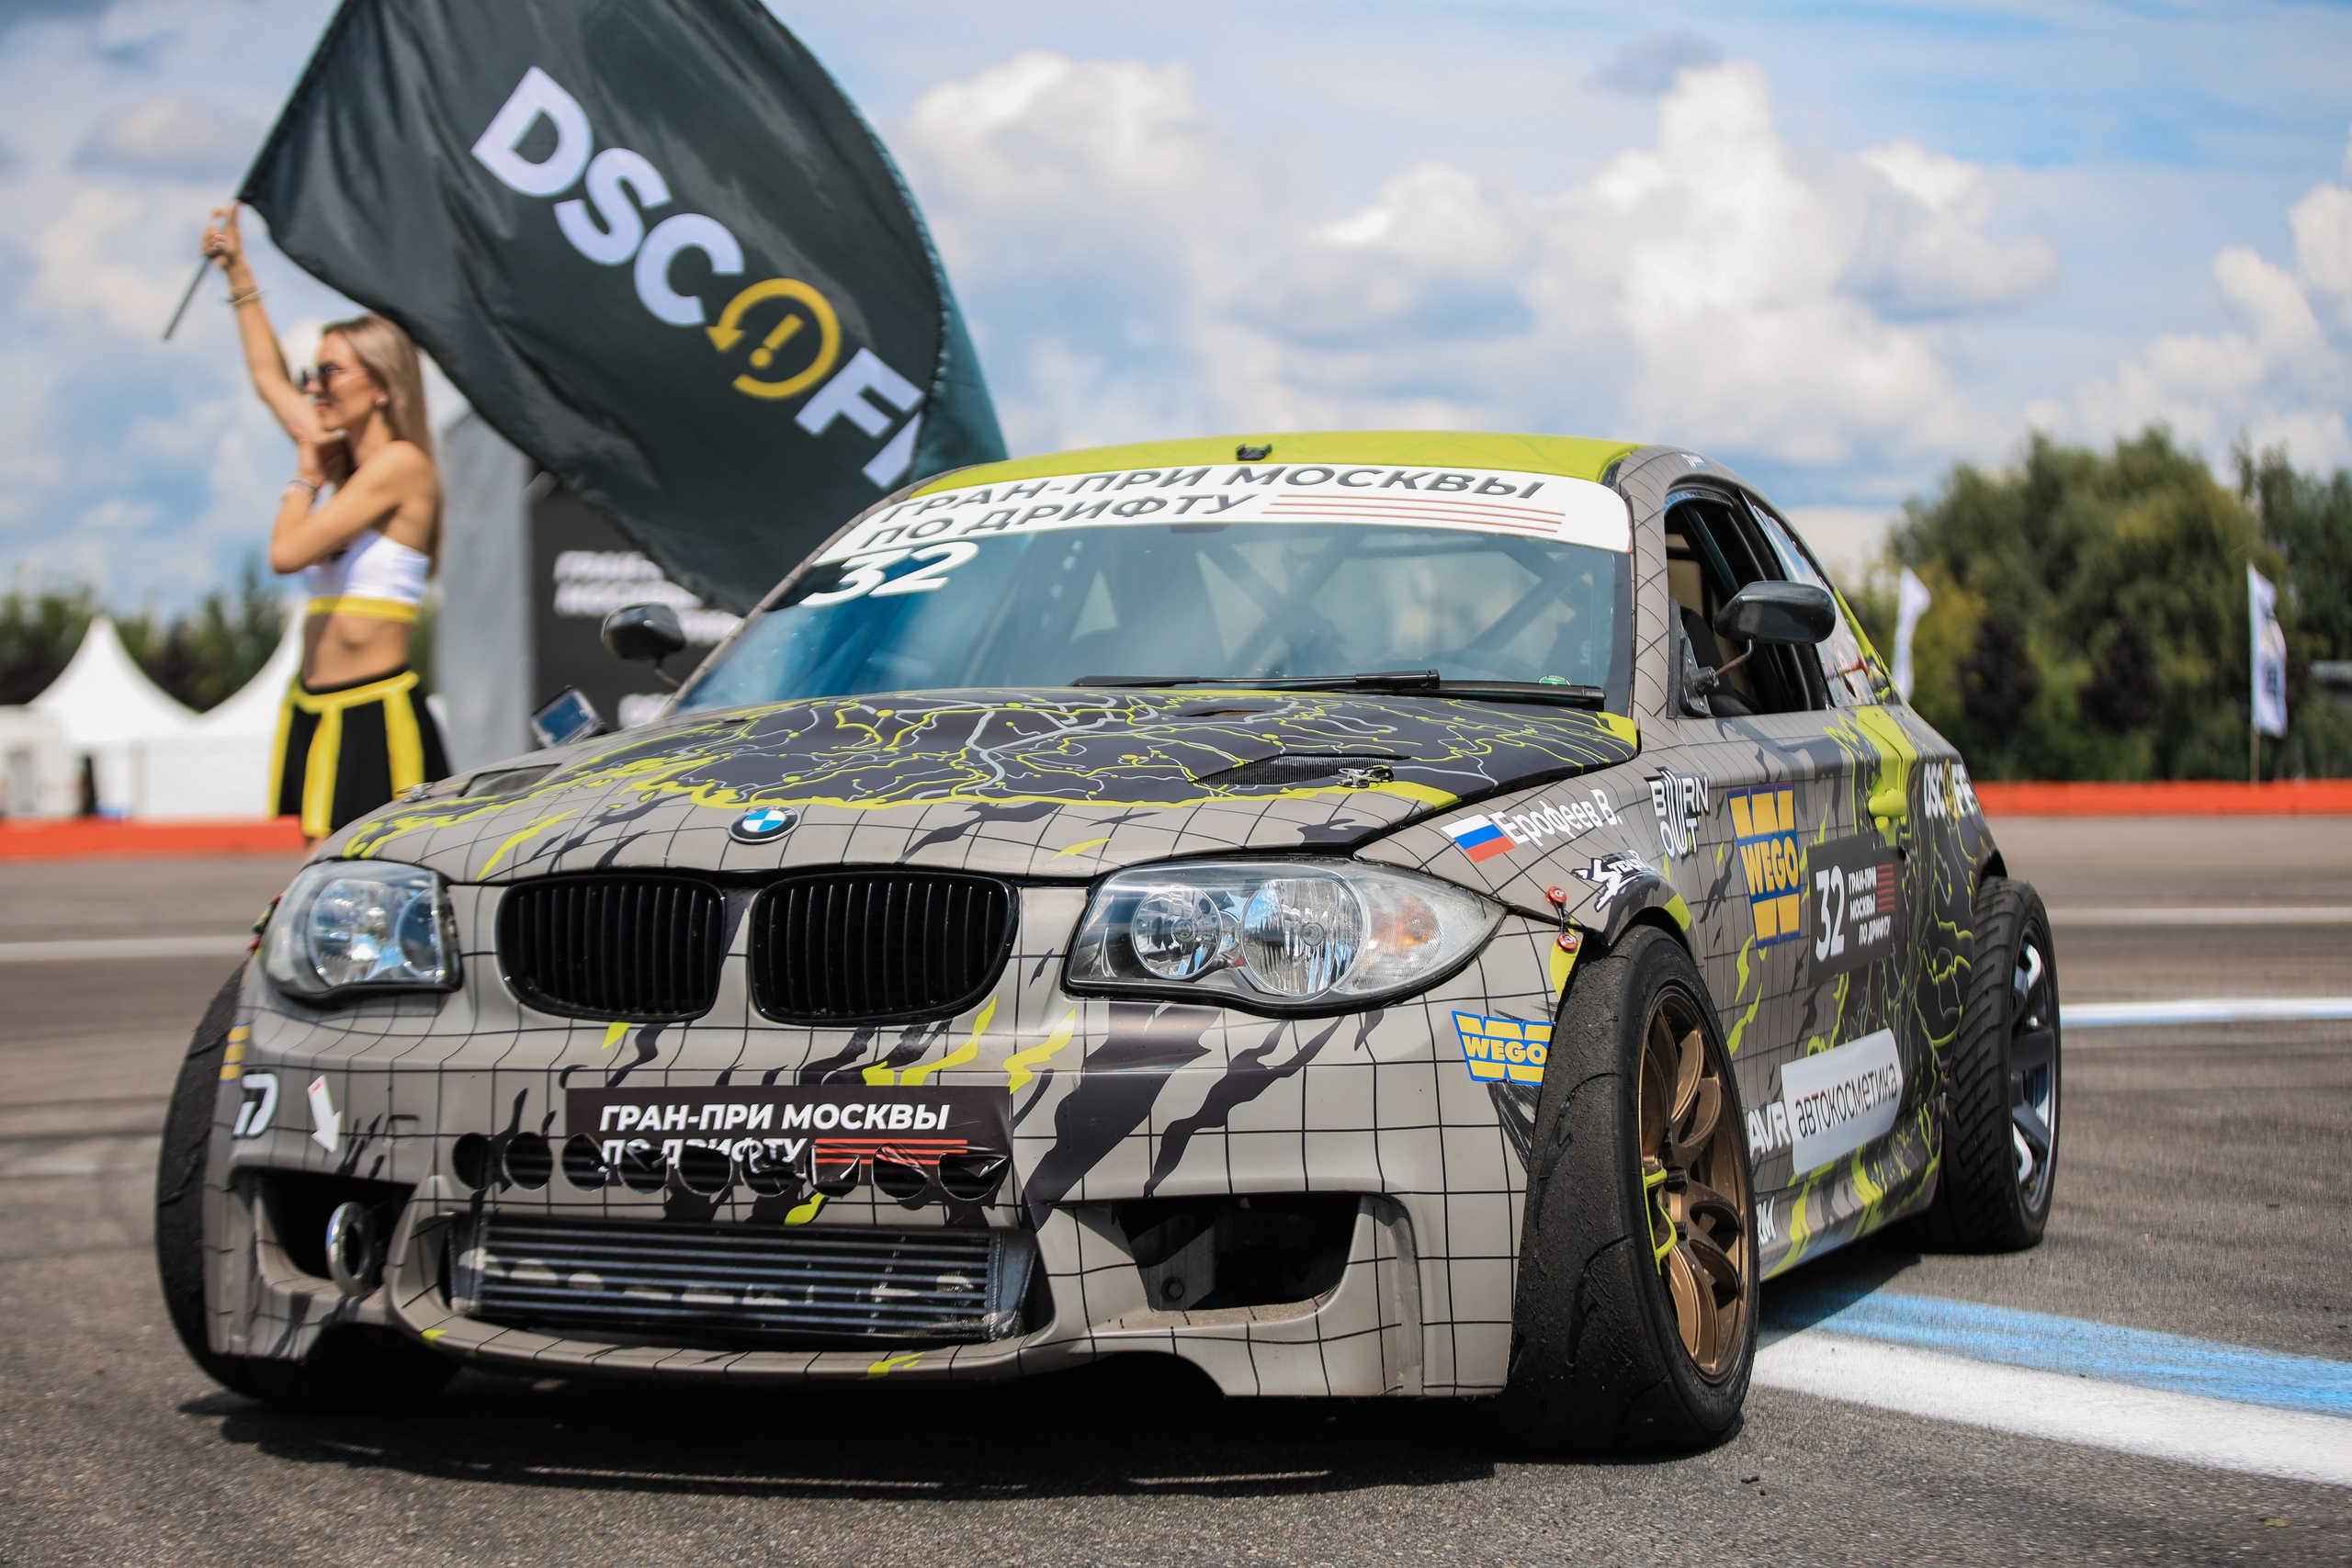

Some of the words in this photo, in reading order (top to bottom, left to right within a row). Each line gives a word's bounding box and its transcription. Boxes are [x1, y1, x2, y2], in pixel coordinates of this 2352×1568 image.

[859, 516, 955, 549] ПО
[960, 492, 1260, 535] ДРИФТУ
[880, 466, 1213, 524] ГРАН-ПРИ
[1222, 466, 1546, 500] МОСКВЫ
[798, 540, 980, 609] 32
[1488, 799, 1604, 848] Ерофеев
[1590, 788, 1623, 826] В.
[1739, 836, 1800, 897] WEGO
[1848, 865, 1877, 897] ГРАН-ПРИ
[1815, 864, 1846, 963] 32
[1849, 892, 1876, 924] МОСКВЫ
[1858, 921, 1869, 947] ПО
[1461, 1034, 1548, 1066] WEGO
[598, 1103, 775, 1132] ГРАН-ПРИ
[780, 1103, 951, 1131] МОСКВЫ
[1795, 1061, 1898, 1138] автокосметика
[661, 1136, 808, 1170] ДФТУ
[1747, 1100, 1792, 1160] AVR
